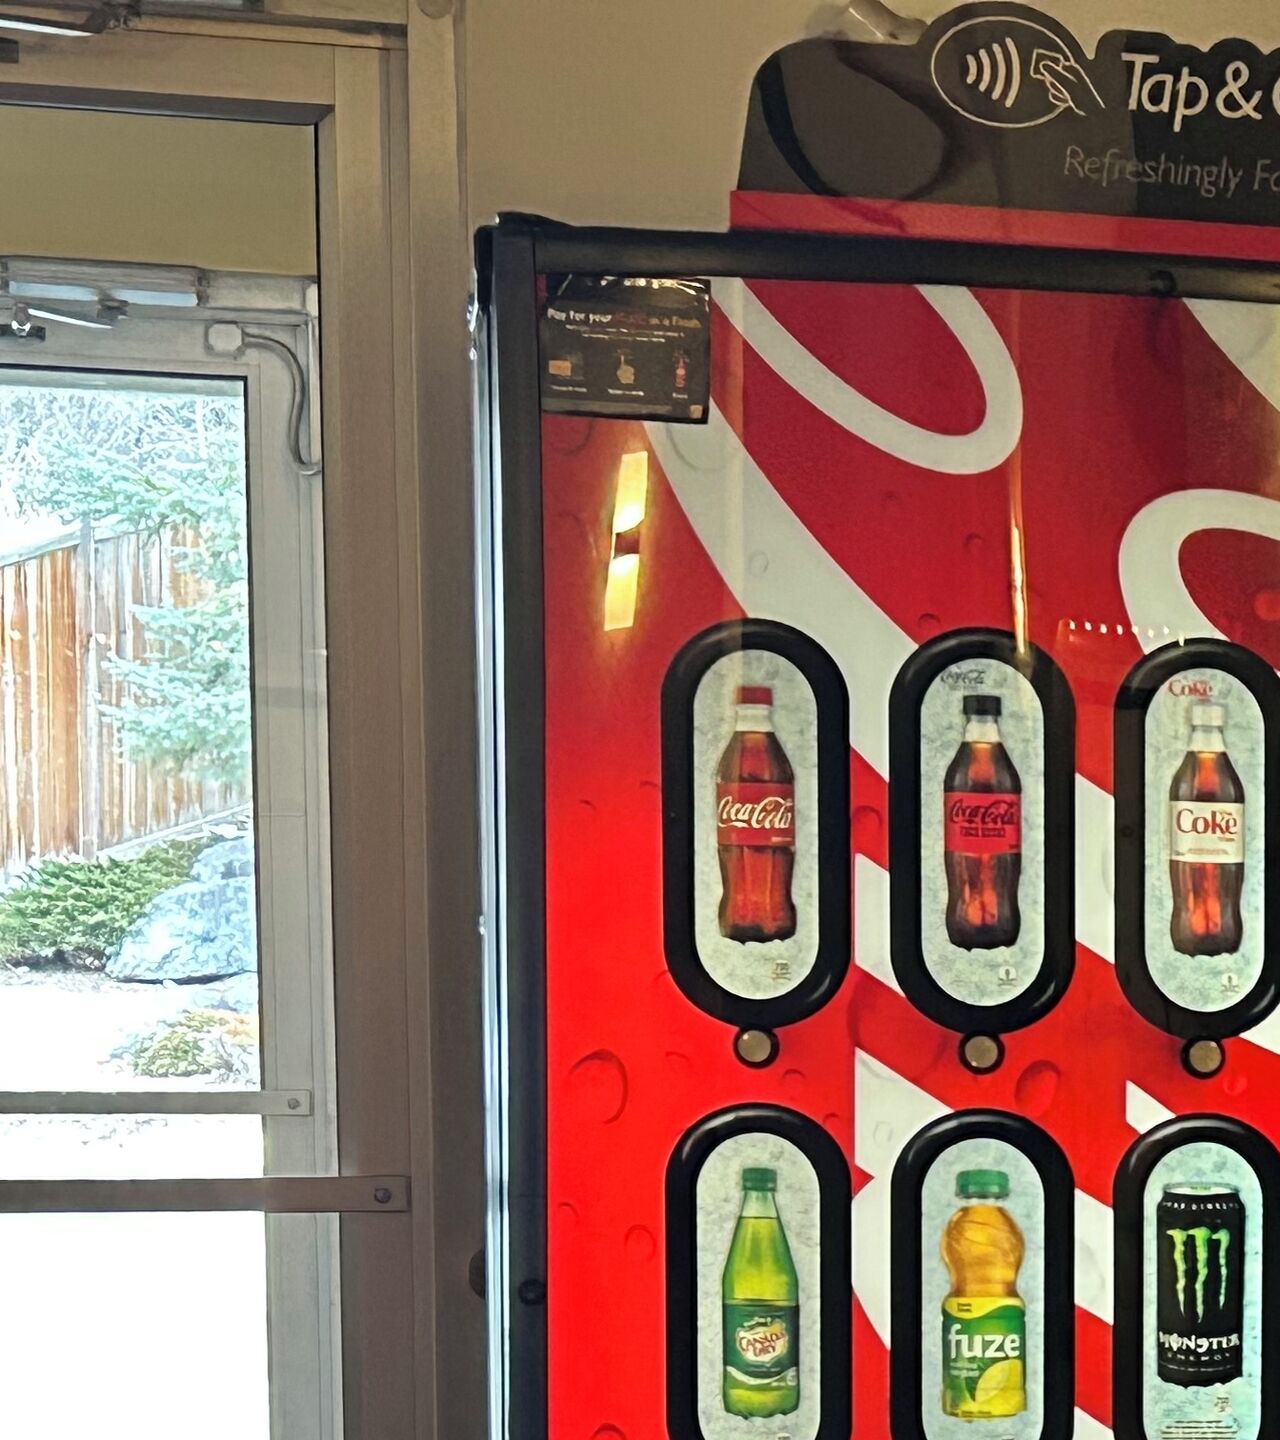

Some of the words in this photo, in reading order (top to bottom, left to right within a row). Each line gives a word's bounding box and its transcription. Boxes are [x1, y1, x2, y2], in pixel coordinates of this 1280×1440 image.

[1064, 146, 1243, 197] Refreshingly
[1176, 808, 1237, 835] Coke
[948, 1323, 1020, 1359] fuze
[1159, 1331, 1240, 1353] MONSTER
